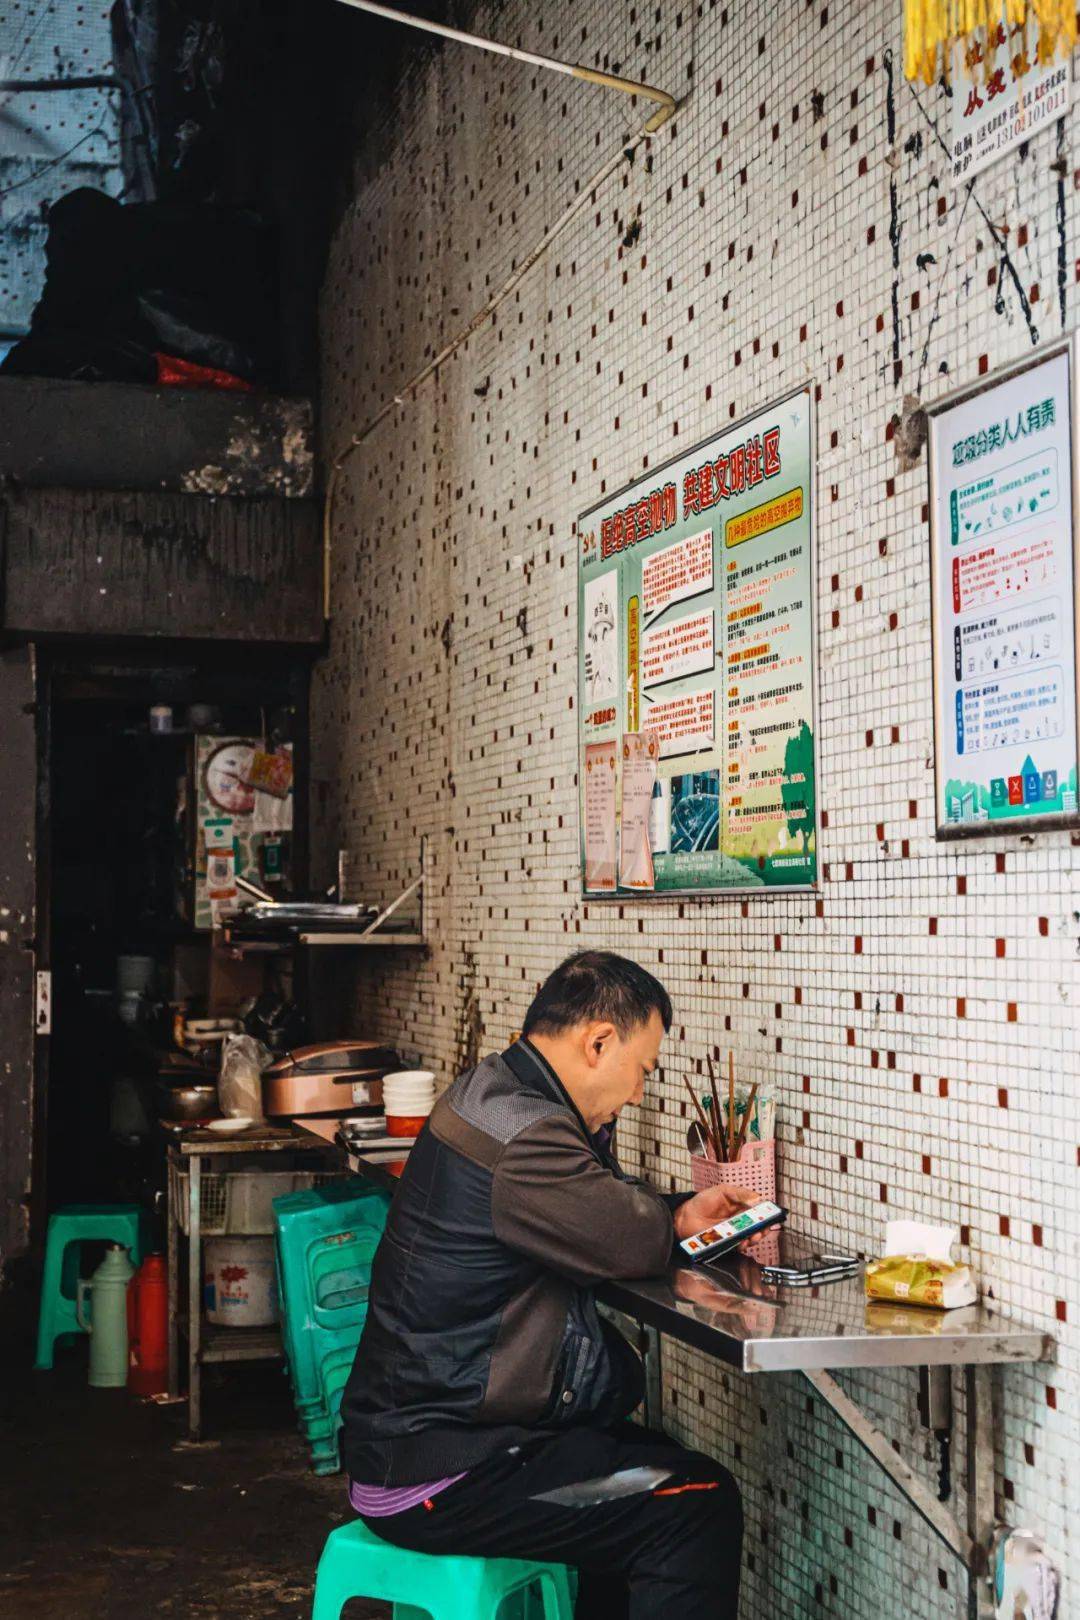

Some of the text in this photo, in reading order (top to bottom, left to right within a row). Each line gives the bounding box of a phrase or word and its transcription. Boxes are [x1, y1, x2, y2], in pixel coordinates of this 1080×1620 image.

[954, 134, 973, 157] 电脑
[953, 398, 1055, 466] 垃圾分类人人有责
[601, 482, 677, 561] 拒绝高空抛物
[683, 426, 781, 520] 共建文明社区
